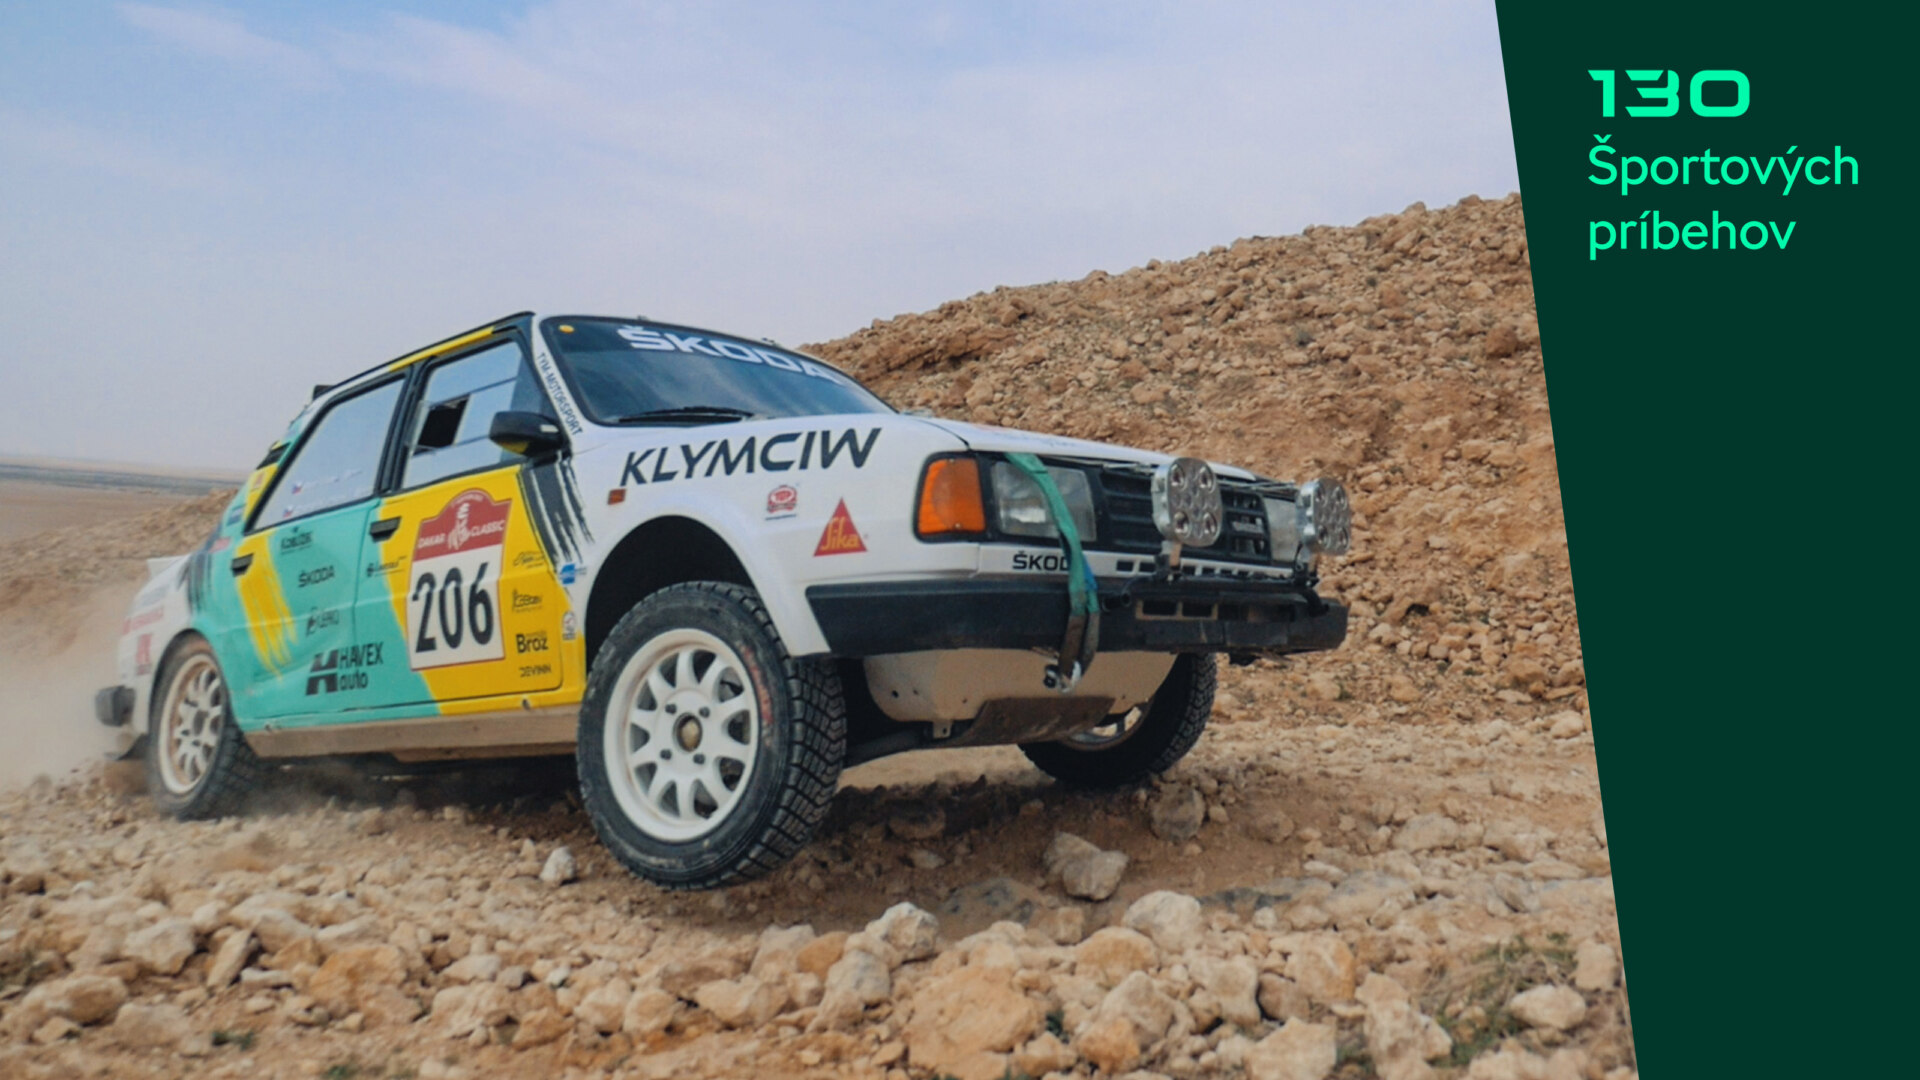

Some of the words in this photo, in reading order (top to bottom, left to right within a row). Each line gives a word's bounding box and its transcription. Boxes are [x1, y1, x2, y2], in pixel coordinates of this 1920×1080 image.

[617, 324, 845, 387] ŠKODA
[620, 428, 882, 487] KLYMCIW
[1012, 550, 1070, 571] ŠKOD
[411, 562, 494, 653] 206
[339, 642, 384, 669] HAVEX
[516, 632, 549, 654] Broz
[339, 671, 369, 692] auto
